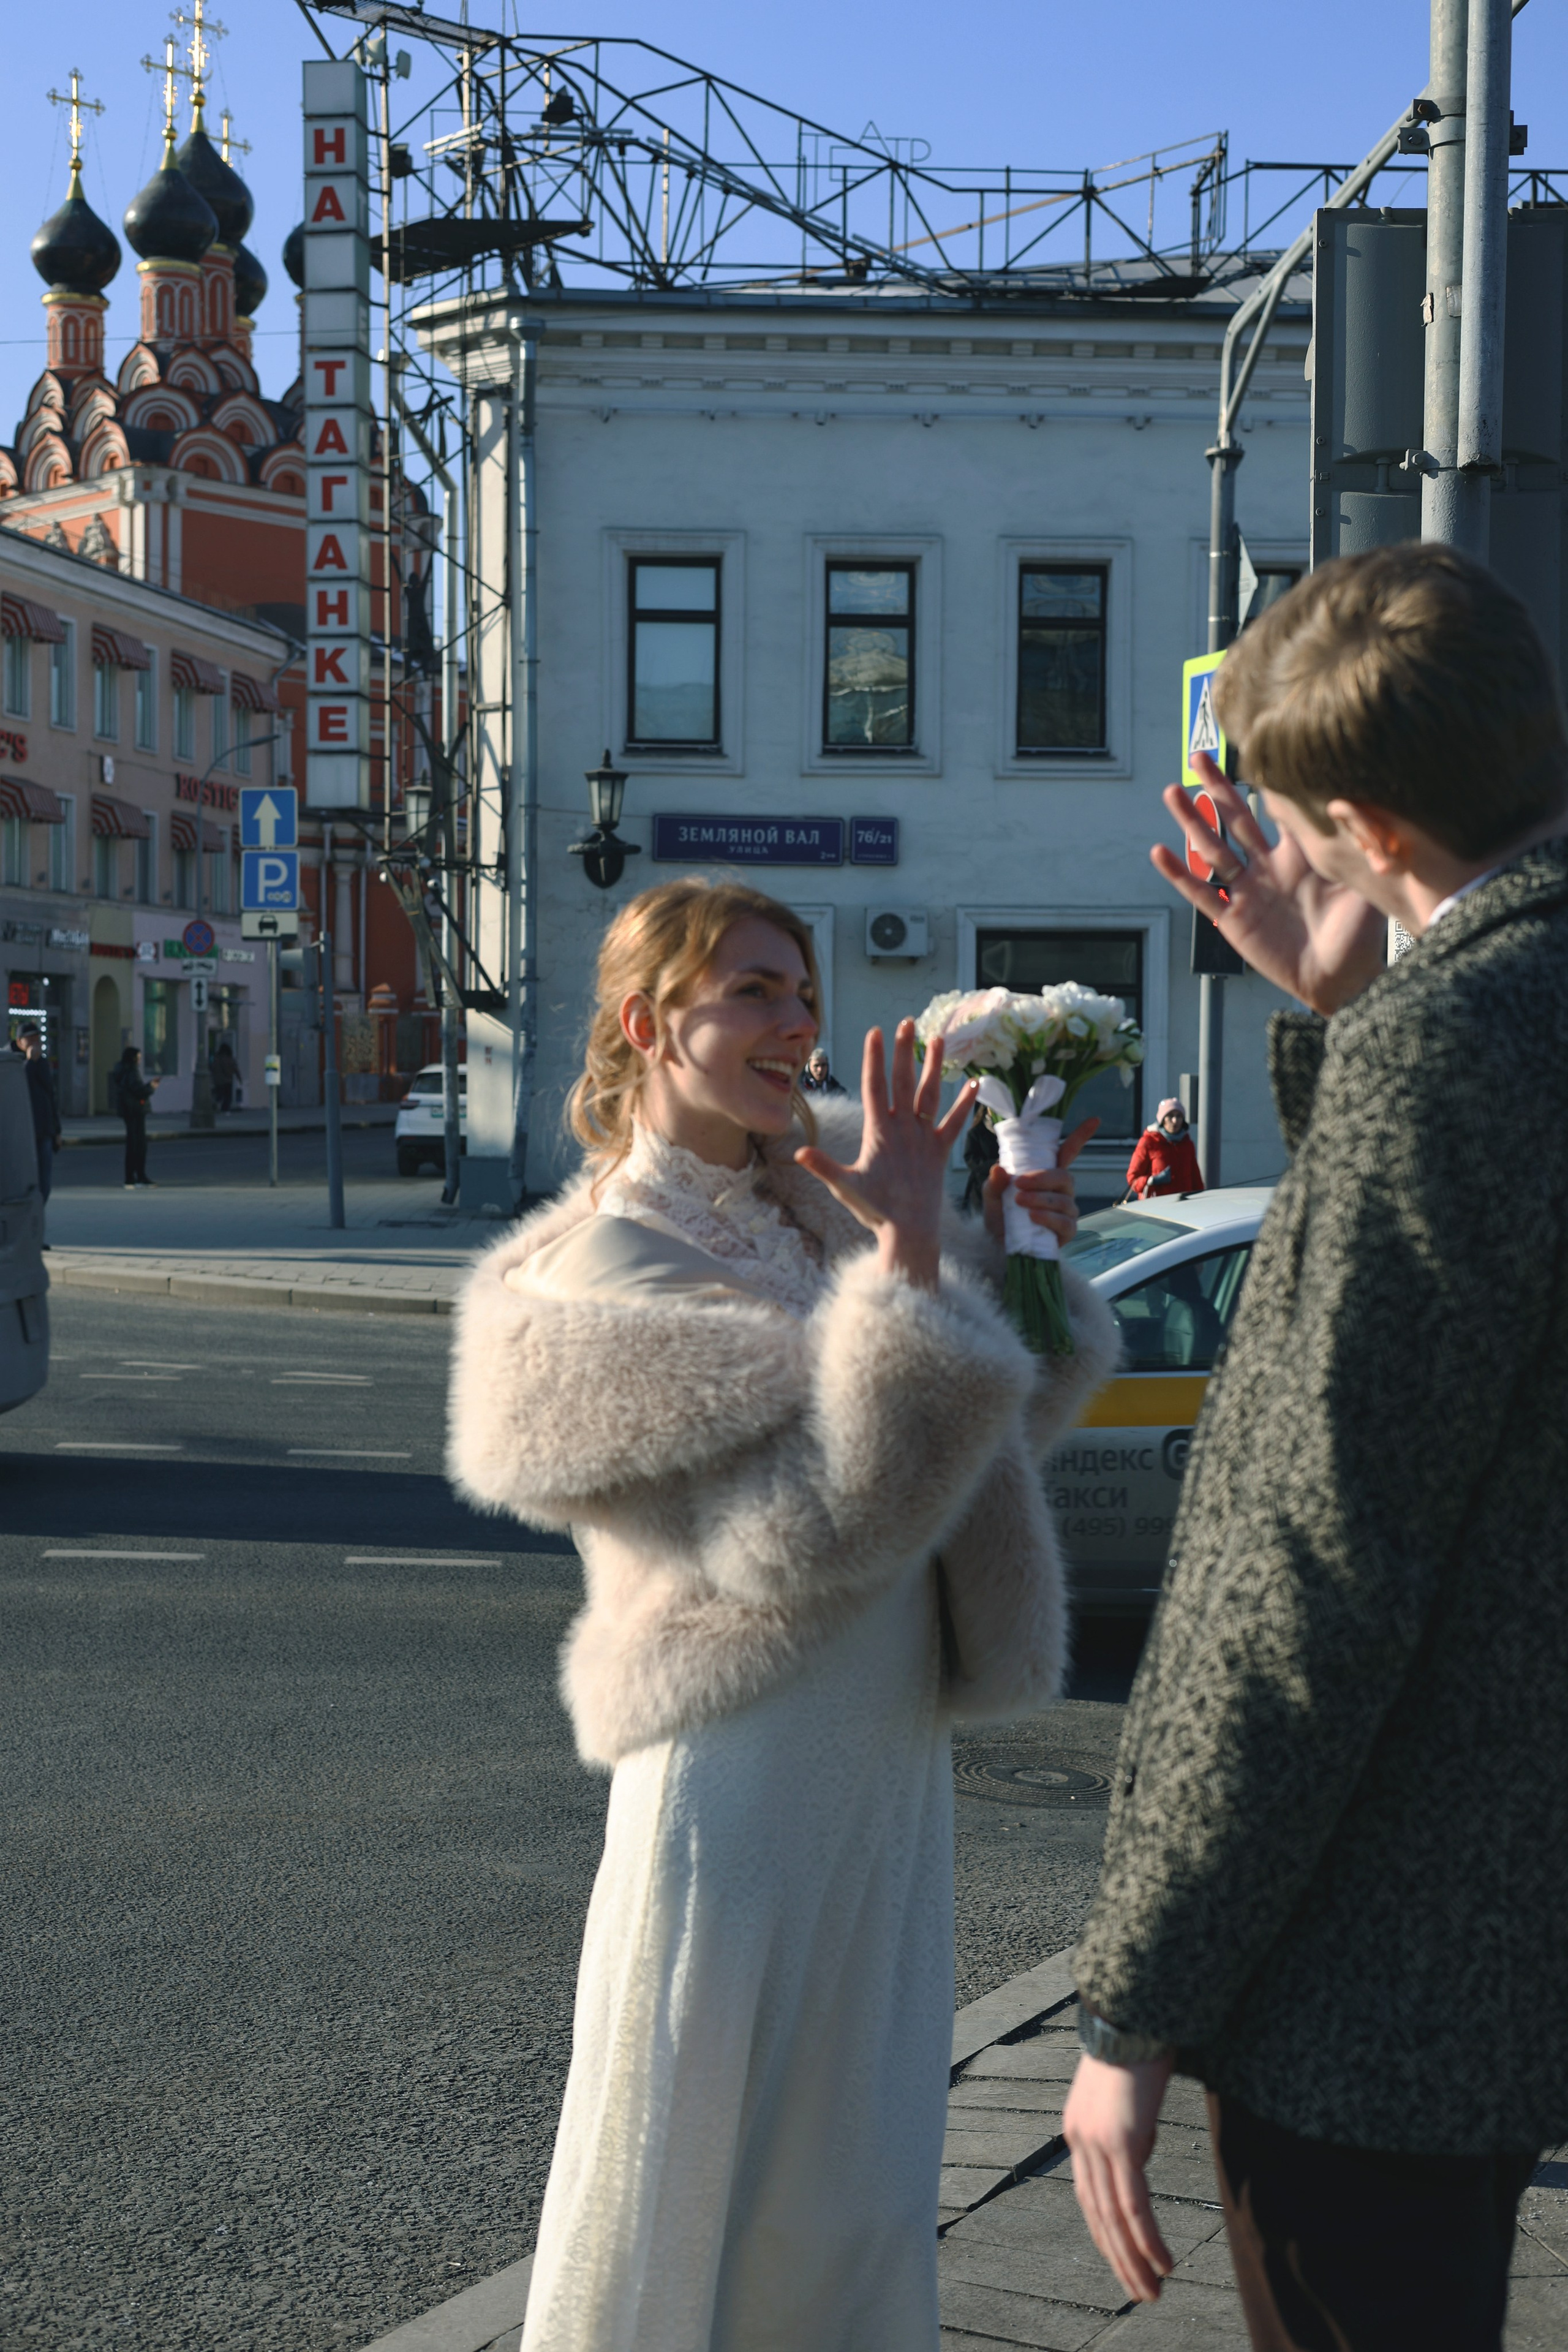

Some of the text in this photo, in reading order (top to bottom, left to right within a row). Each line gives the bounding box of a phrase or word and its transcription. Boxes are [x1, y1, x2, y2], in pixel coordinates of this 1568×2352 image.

[311, 127, 349, 742] НА ТАГАНКЕ
[678, 826, 820, 845] ЗЕМЛЯНОЙ ВАЛ
[856, 829, 892, 845] 76/21
[727, 845, 769, 854] УЛИЦА
[258, 858, 288, 903] P
[1063, 1516, 1126, 1539] (495)
